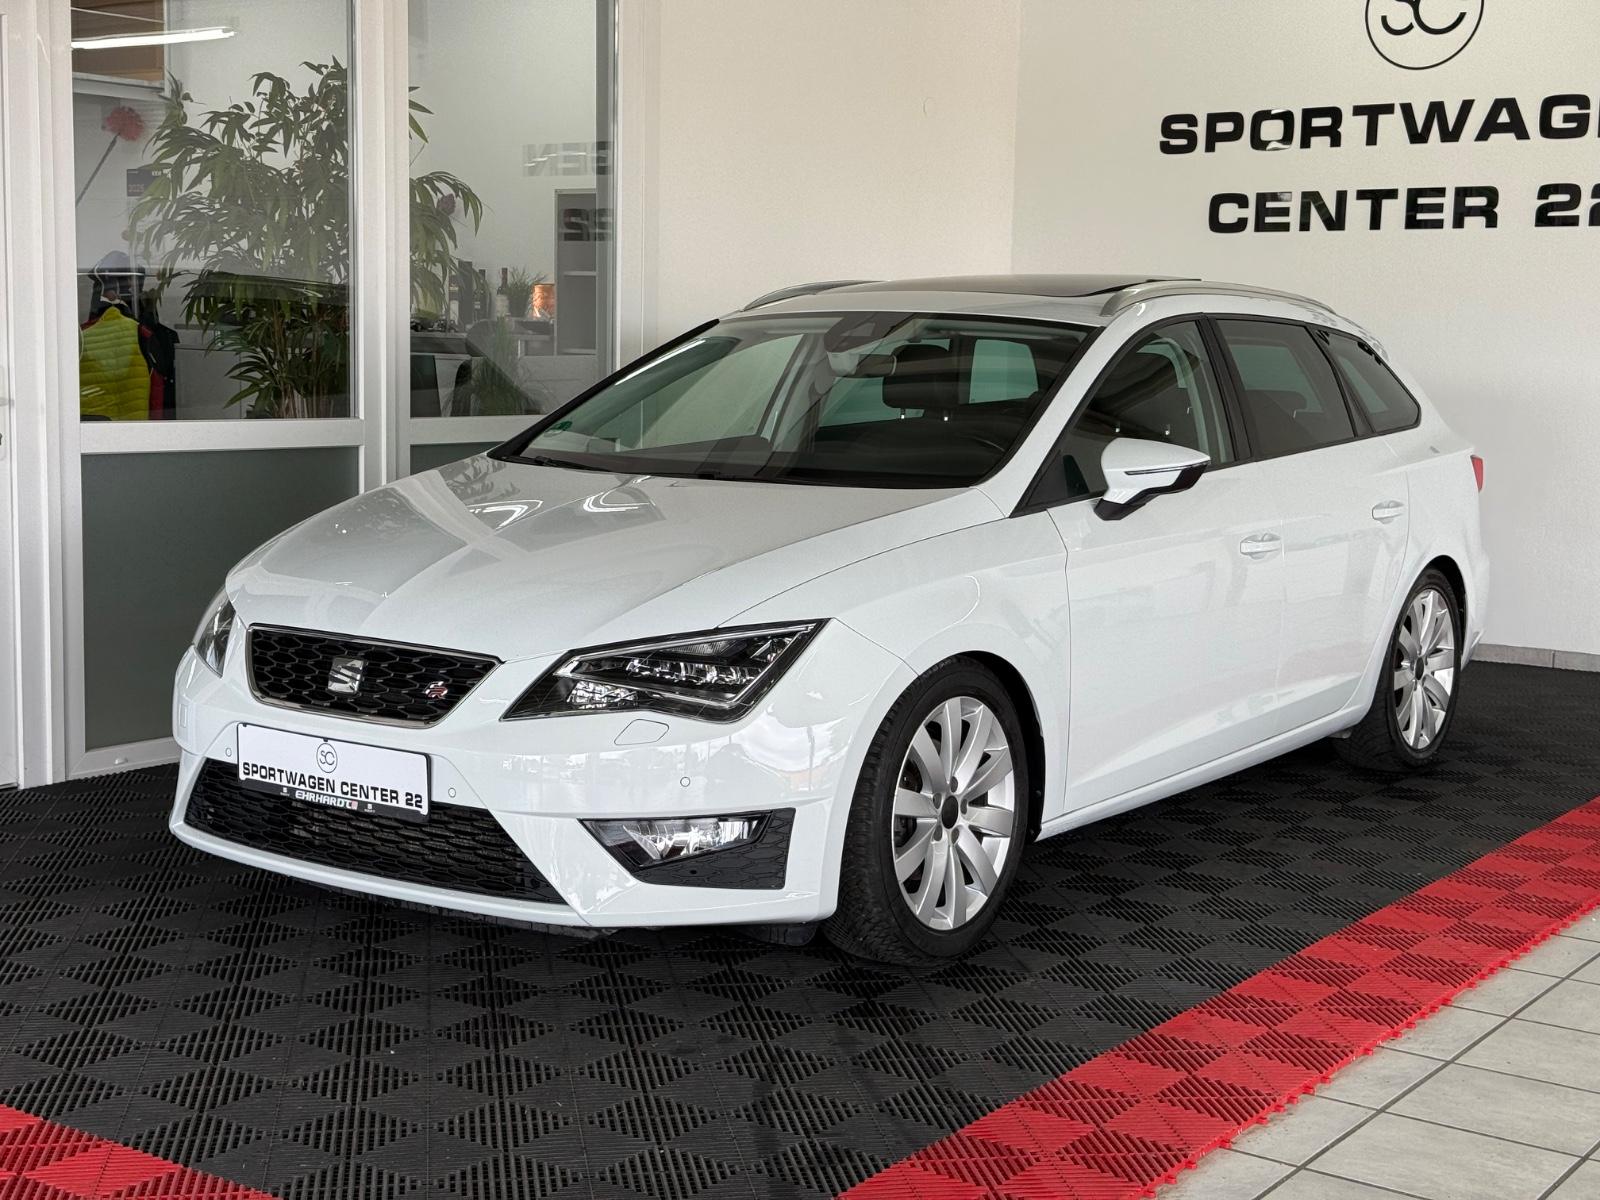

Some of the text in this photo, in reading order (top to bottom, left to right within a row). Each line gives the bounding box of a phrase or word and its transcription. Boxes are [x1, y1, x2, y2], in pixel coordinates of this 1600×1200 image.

[1159, 94, 1600, 155] SPORTWAG
[1208, 183, 1600, 234] CENTER 2
[242, 762, 423, 809] SPORTWAGEN CENTER 22
